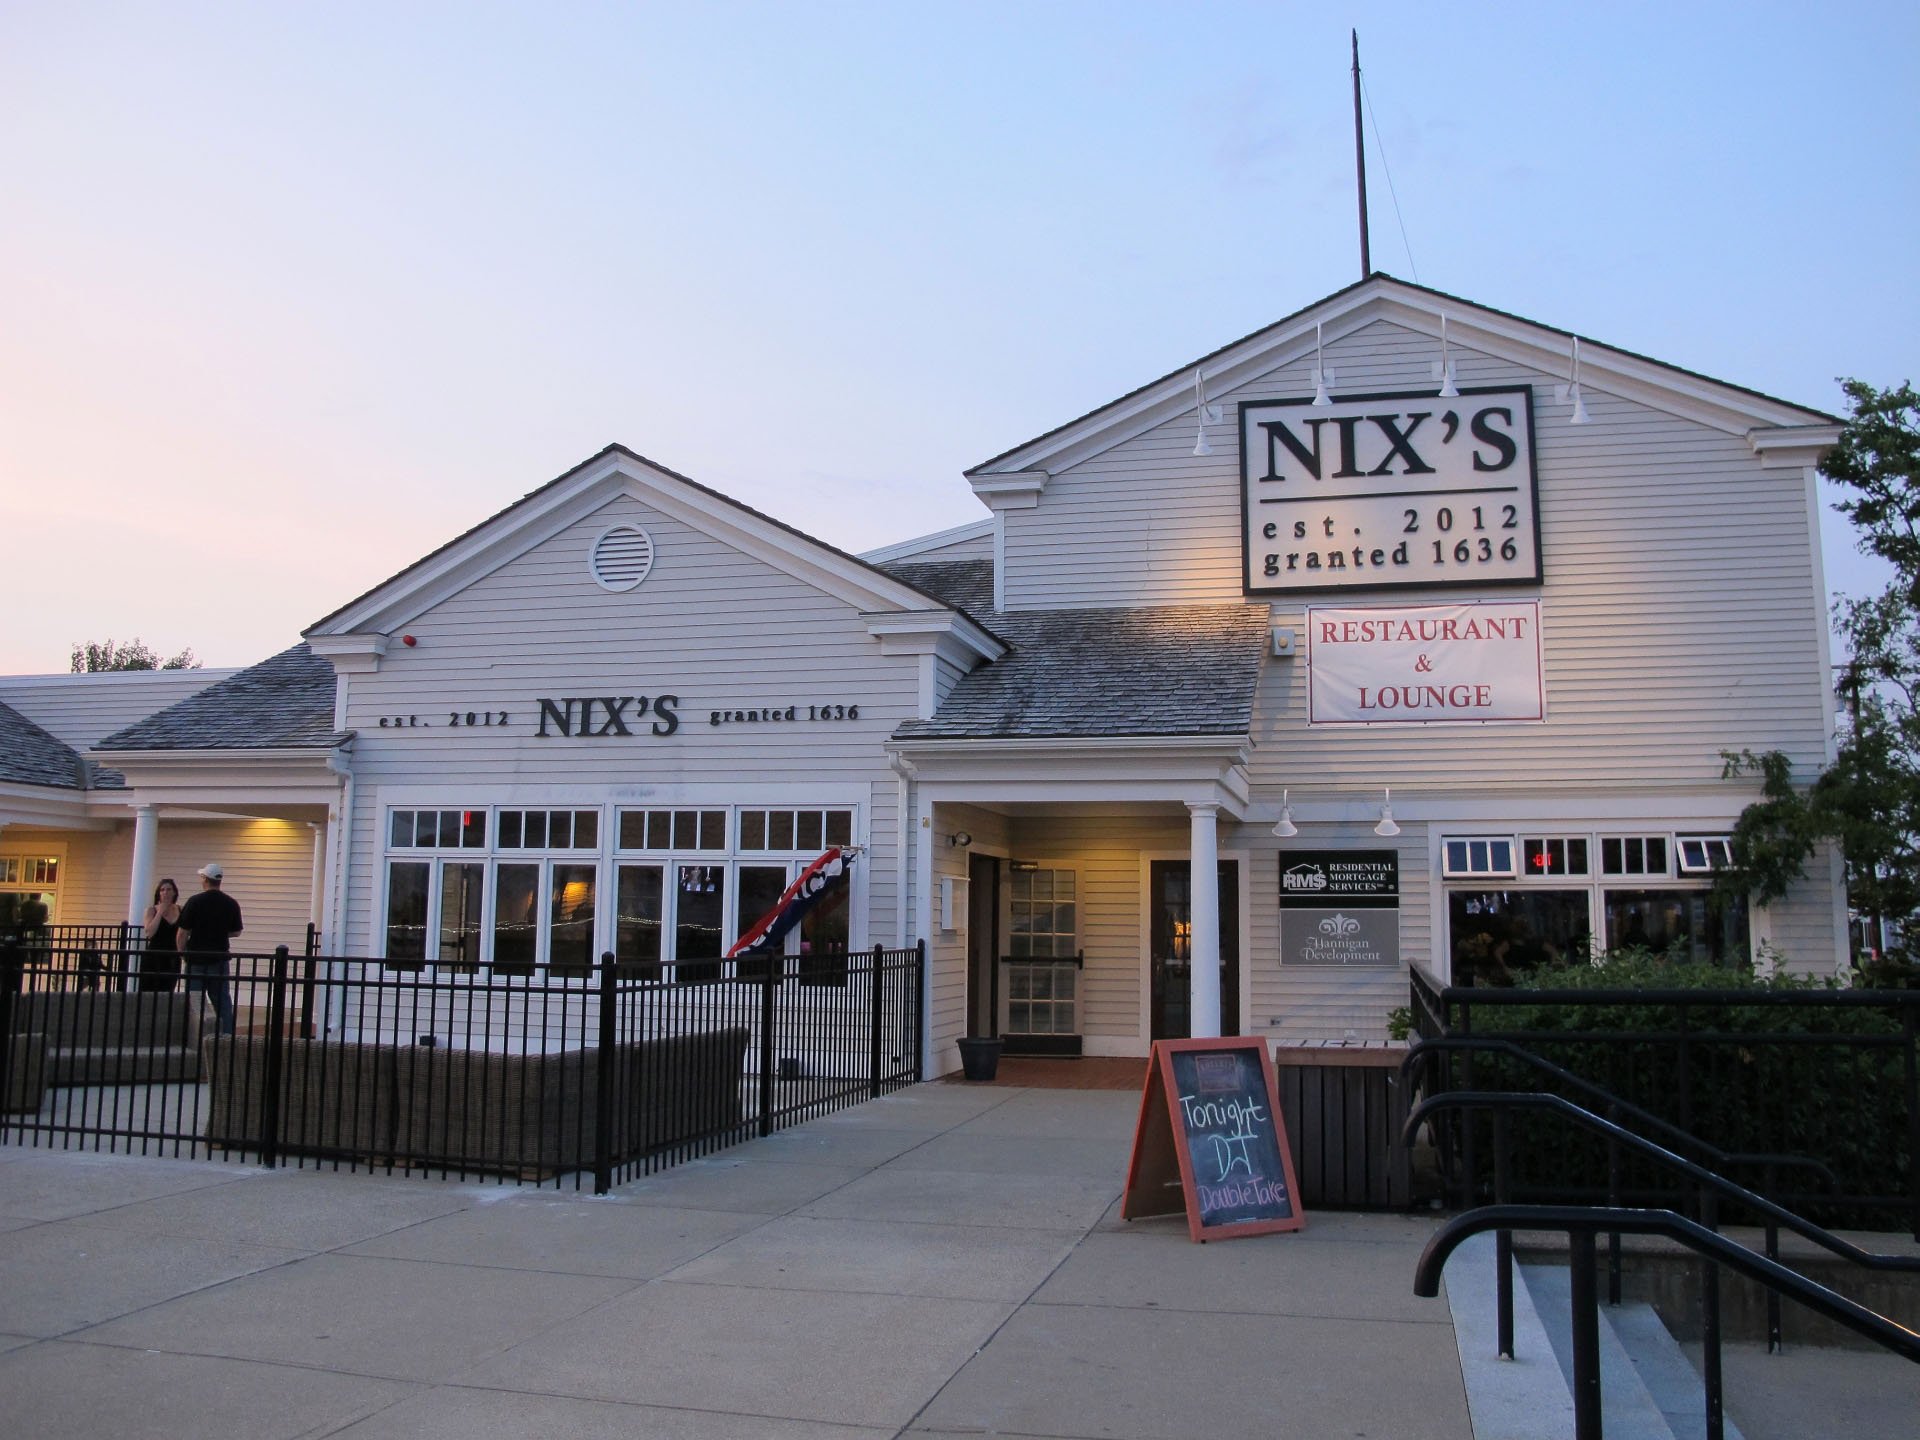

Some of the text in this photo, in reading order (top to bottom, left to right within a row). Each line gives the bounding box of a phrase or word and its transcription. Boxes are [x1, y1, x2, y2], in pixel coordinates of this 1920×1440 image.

[1257, 406, 1517, 482] NIX'S
[1262, 504, 1518, 539] est. 2012
[1263, 537, 1517, 576] granted 1636
[1319, 616, 1527, 644] RESTAURANT
[1414, 653, 1433, 672] &
[1357, 685, 1492, 709] LOUNGE
[379, 694, 858, 738] est. 2012 NIX'S granted 1636
[1329, 863, 1395, 871] RESIDENTIAL
[1329, 873, 1386, 881] MORTGAGE
[1283, 873, 1327, 889] RMS
[1329, 882, 1377, 891] SERVICES
[1302, 947, 1381, 963] Development
[1308, 937, 1369, 952] Hannigan
[1179, 1095, 1267, 1138] Tonight
[1208, 1134, 1258, 1182] DJ
